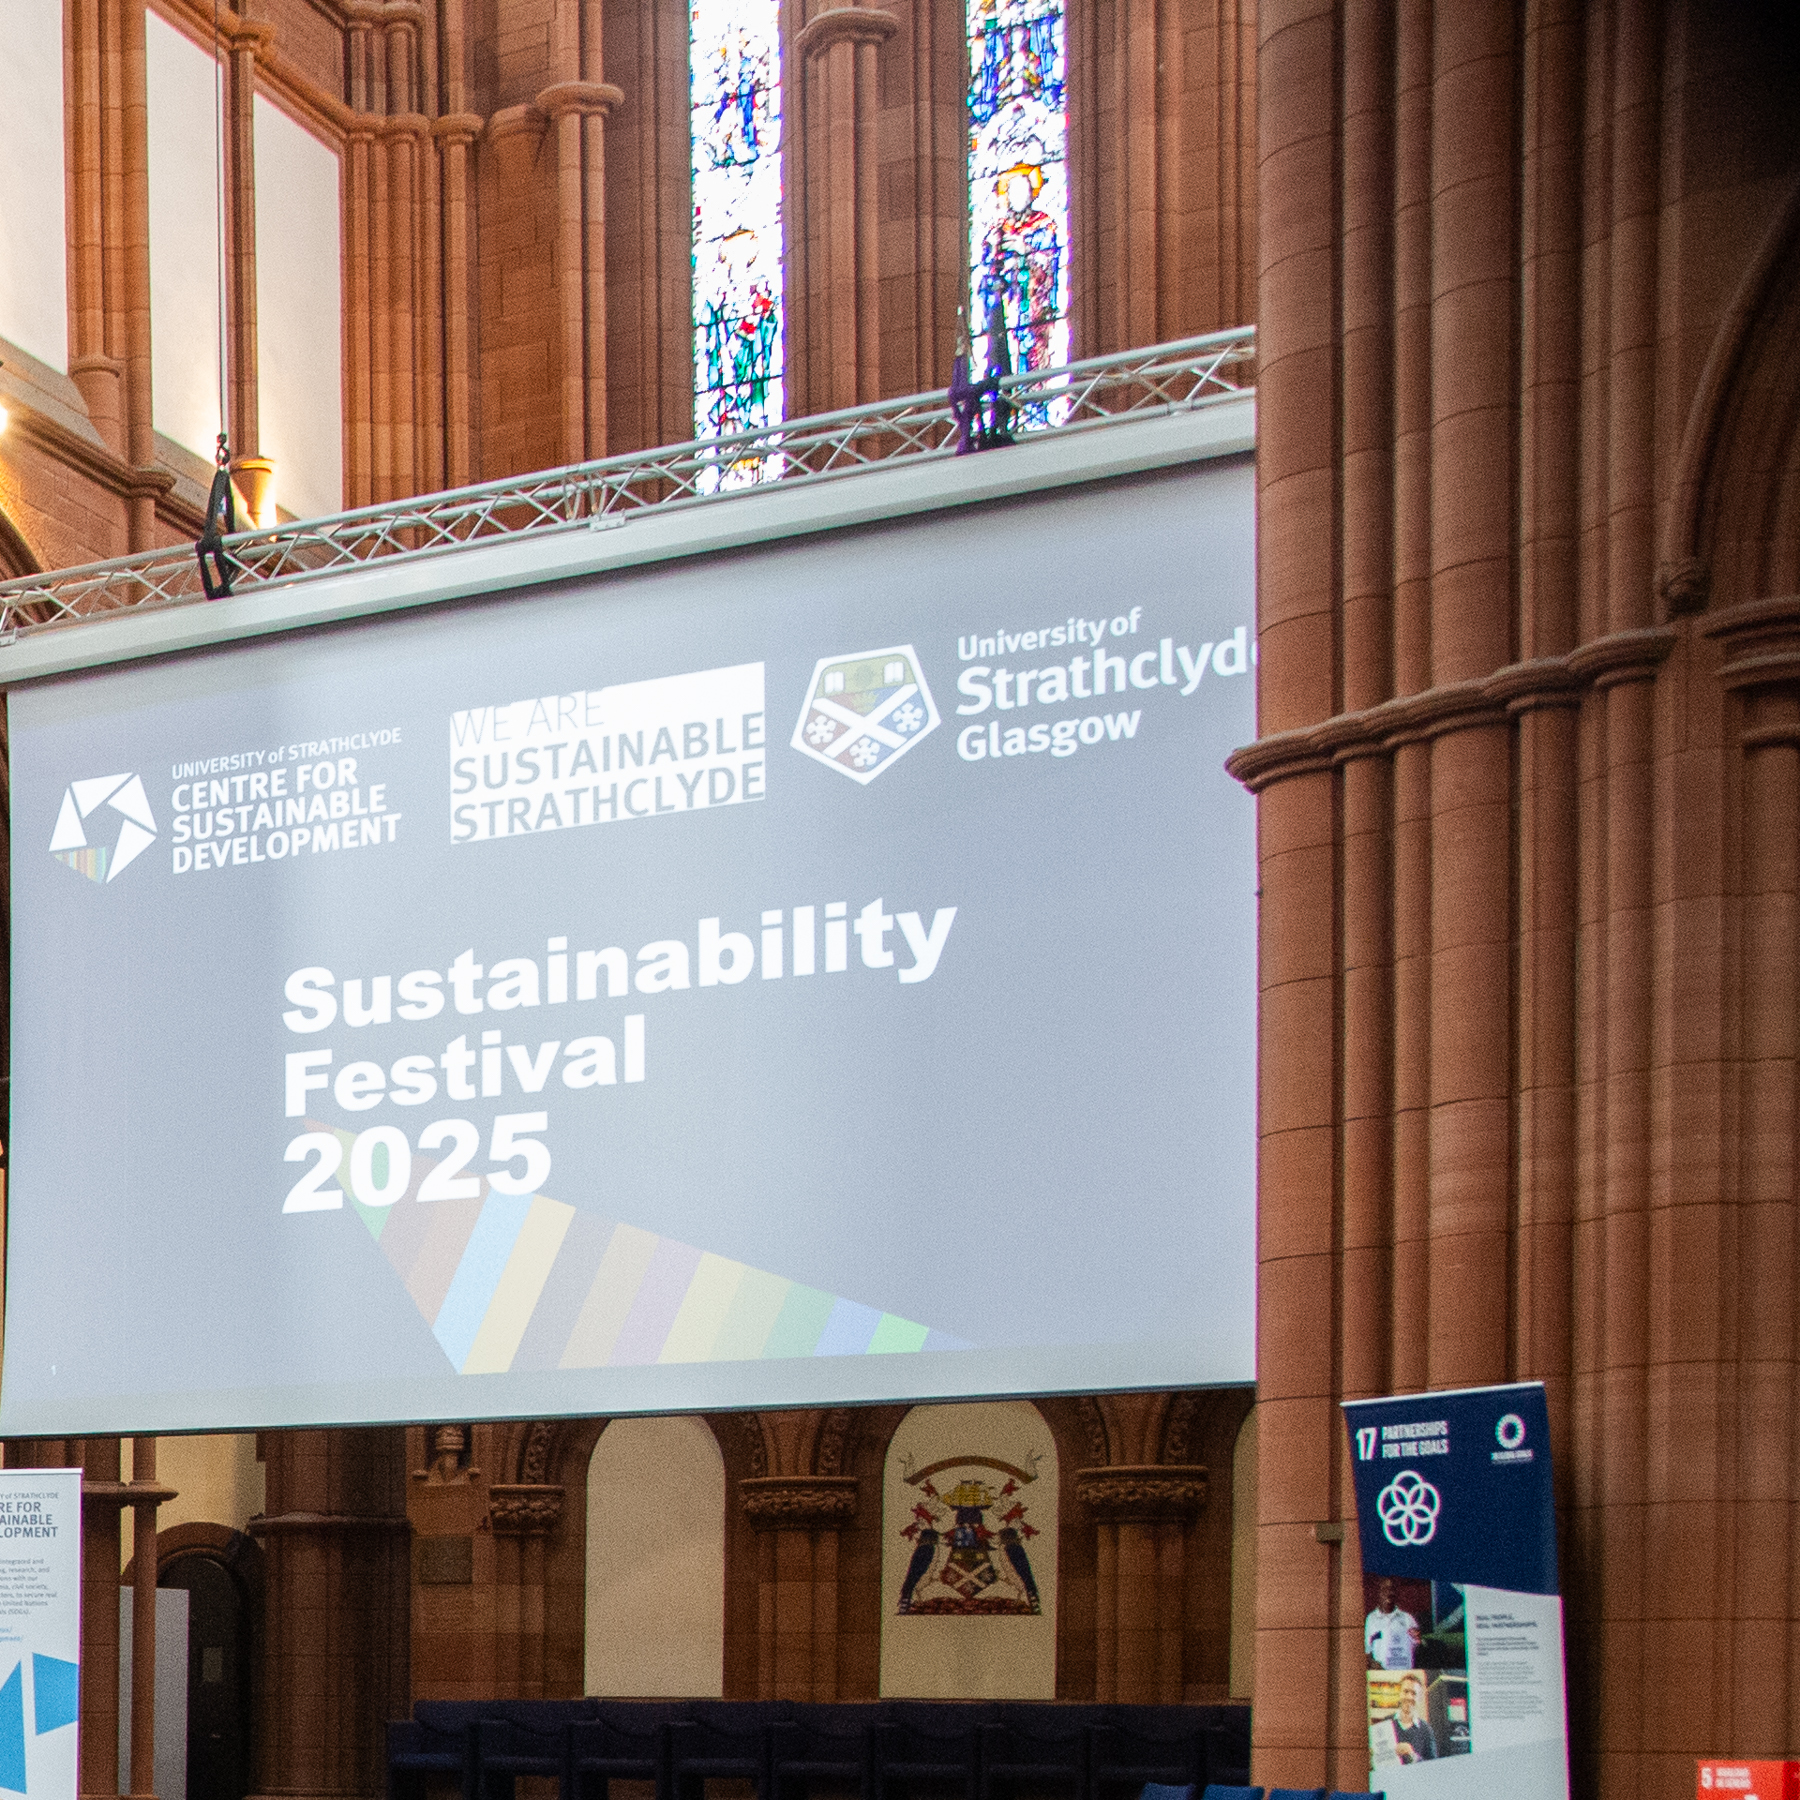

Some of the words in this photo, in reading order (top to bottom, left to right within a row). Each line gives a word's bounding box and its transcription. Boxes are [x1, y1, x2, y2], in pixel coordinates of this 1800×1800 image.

[958, 617, 1106, 661] University
[1110, 606, 1143, 637] of
[451, 705, 513, 748] WE
[526, 690, 605, 737] ARE
[956, 709, 1142, 762] Glasgow
[172, 749, 265, 780] UNIVERSITY
[267, 746, 284, 764] of
[288, 727, 402, 761] STRATHCLYDE
[452, 711, 765, 795] SUSTAINABLE
[171, 767, 288, 813] CENTRE
[296, 757, 358, 793] FOR
[452, 761, 765, 842] STRATHCLYDE
[171, 783, 387, 844] SUSTAINABLE
[172, 813, 402, 875] DEVELOPMENT
[282, 896, 959, 1034] Sustainability
[284, 1014, 646, 1118] Festival
[281, 1110, 552, 1215] 2025
[1355, 1427, 1378, 1461] 17
[1382, 1420, 1448, 1441] PARTNERSHIPS
[1382, 1443, 1401, 1459] FOR
[1401, 1441, 1419, 1457] THE
[1419, 1439, 1449, 1455] GOALS
[16, 1501, 41, 1513] FOR
[1701, 1766, 1713, 1789] 5
